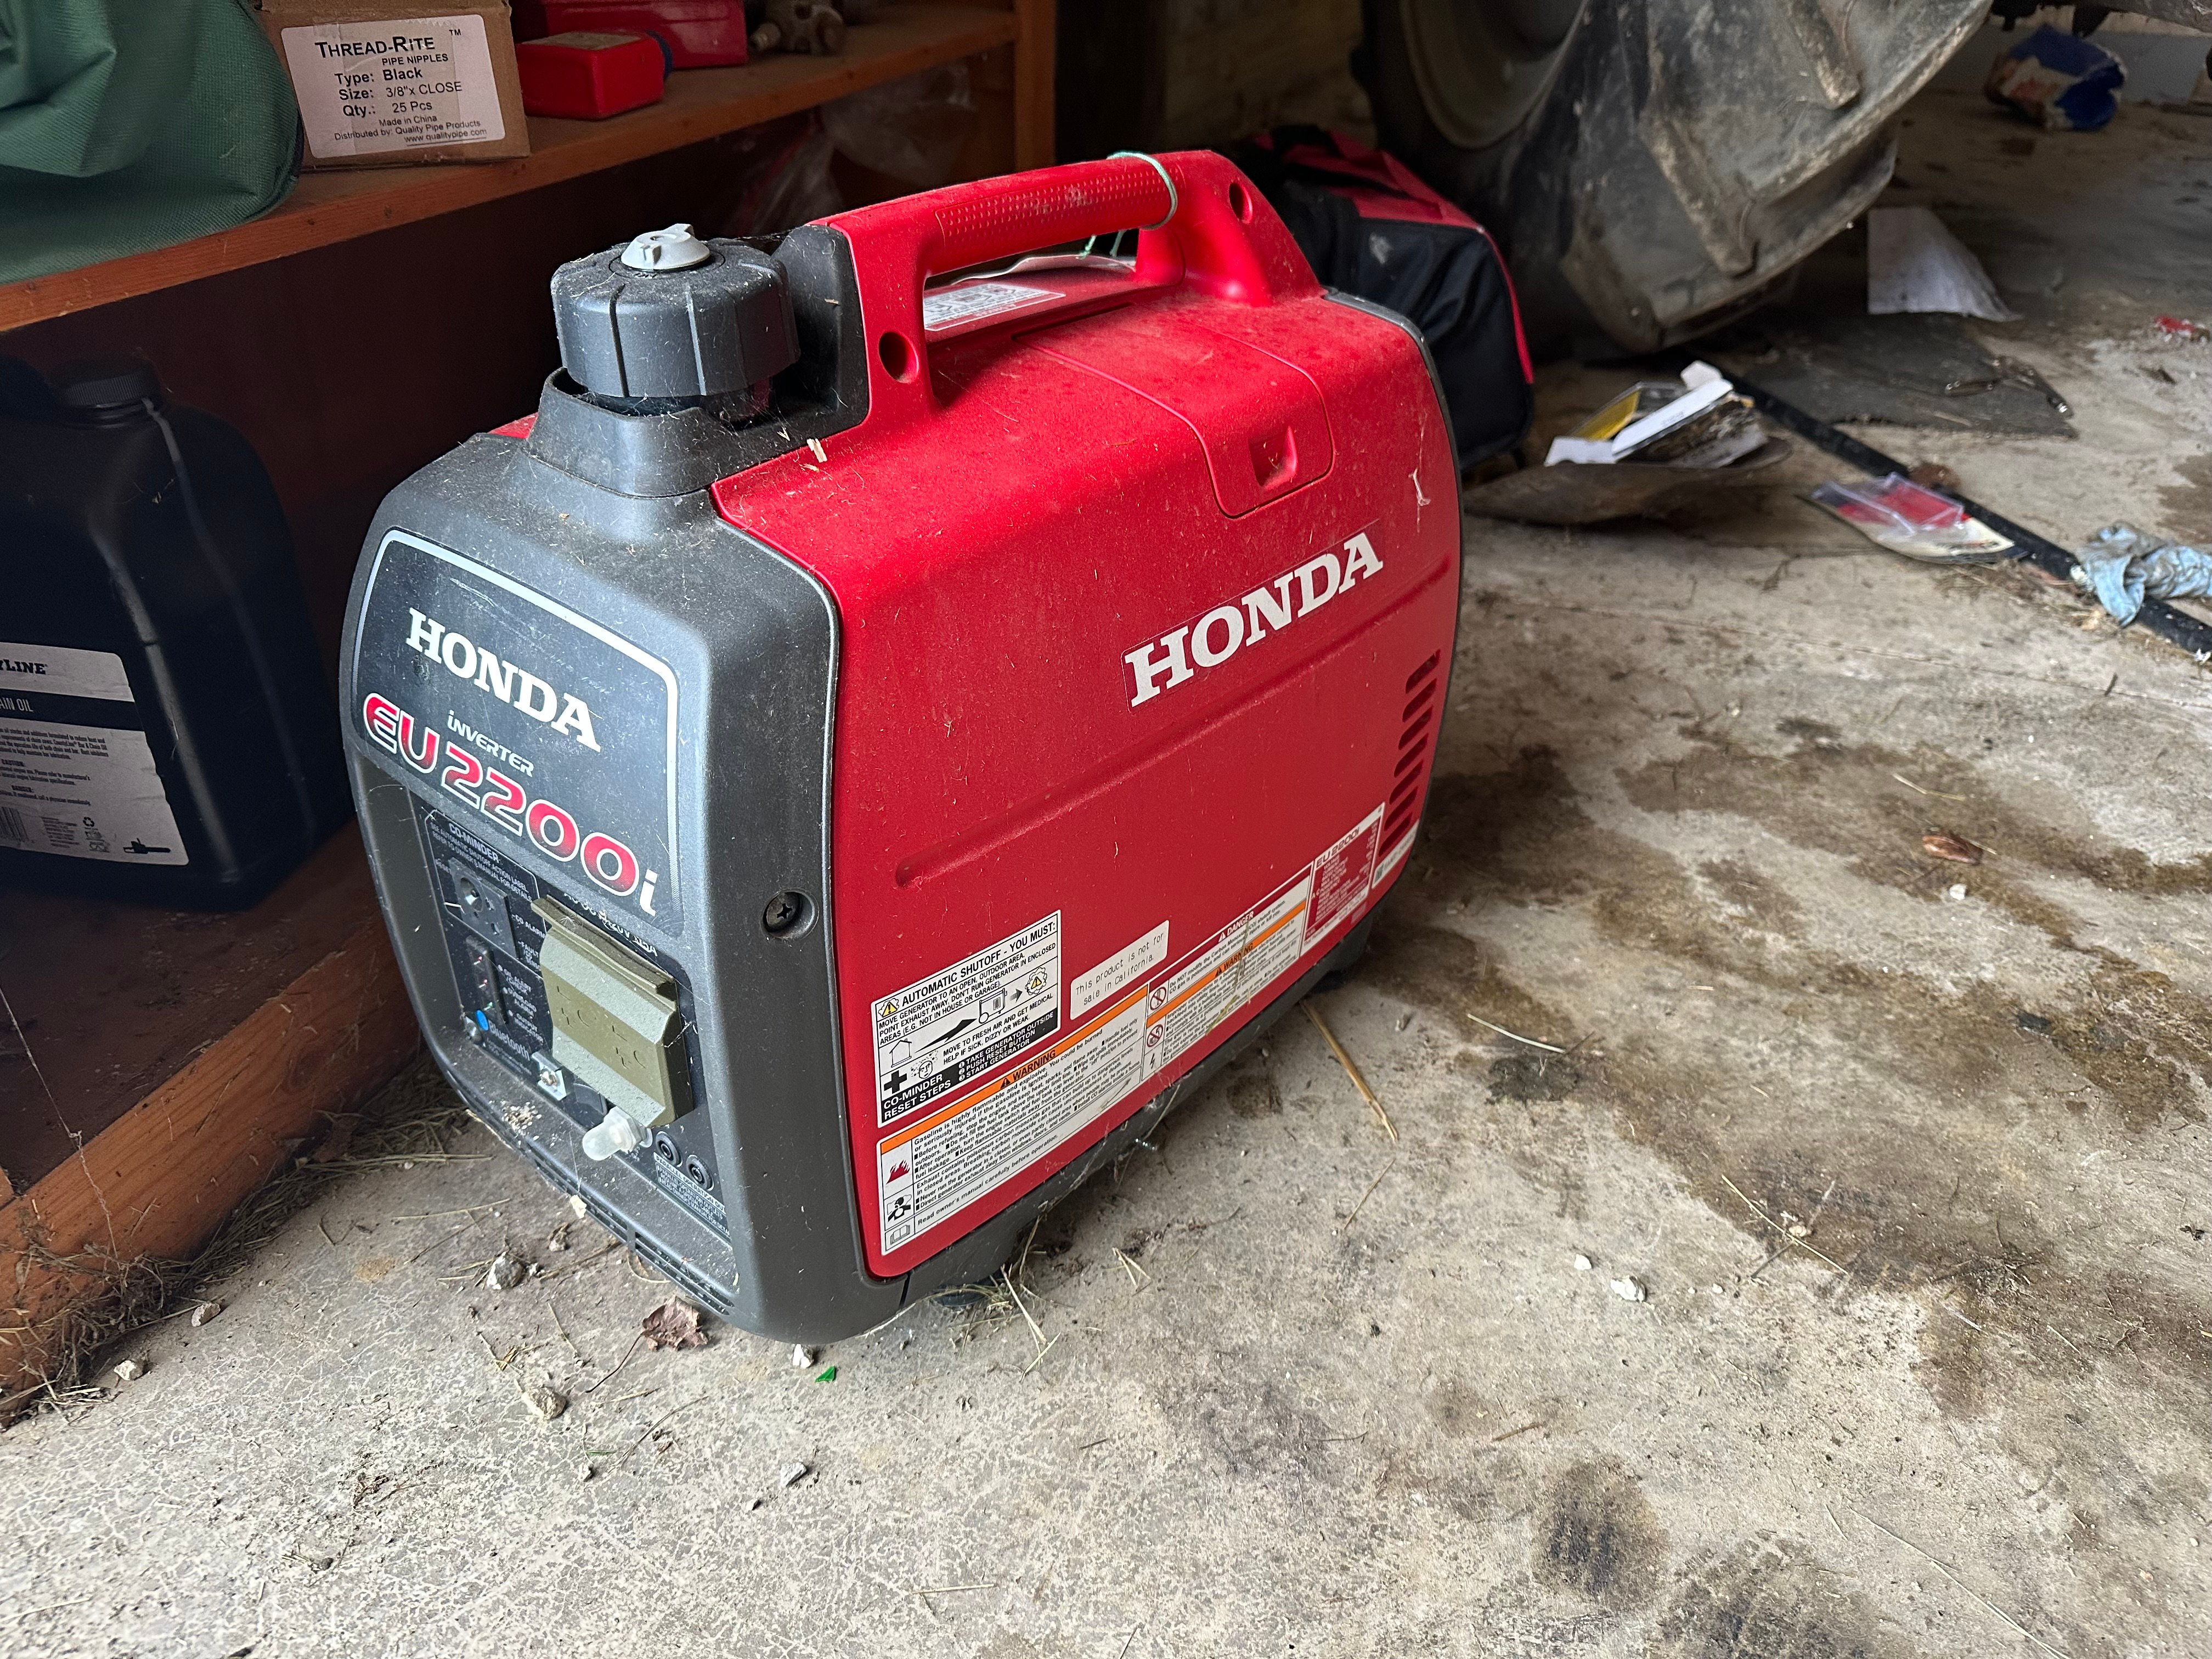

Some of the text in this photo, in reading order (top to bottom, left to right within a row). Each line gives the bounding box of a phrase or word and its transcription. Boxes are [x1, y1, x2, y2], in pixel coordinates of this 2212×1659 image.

[334, 67, 423, 87] Type: Black
[382, 54, 449, 65] PIPE NIPPLES
[339, 89, 374, 100] Size:
[419, 82, 462, 95] CLOSE
[343, 101, 432, 117] Qty.: 25 Pcs
[334, 129, 379, 140] Distributed
[395, 125, 424, 134] Quality
[425, 123, 444, 132] Pipe
[445, 120, 481, 129] Products
[379, 118, 402, 127] Made
[414, 115, 437, 123] China
[1125, 532, 1384, 708] HONDA
[405, 607, 601, 753] HONDA
[16, 698, 33, 712] OIL
[439, 827, 469, 853] AUTOMATIC
[469, 847, 490, 868] SHUTOFF
[492, 862, 511, 882] ACTION
[448, 821, 499, 864] CO-MINDER
[477, 861, 500, 882] MANUAL
[500, 876, 510, 889] FOR
[515, 913, 524, 926] CO
[521, 940, 539, 958] FAULT
[902, 922, 1054, 1006] AUTOMATIC SHUTOFF YOU MUST:
[1076, 933, 1163, 995] This product is not for
[1222, 941, 1254, 972] WARNNG
[503, 967, 531, 992] OIL ALERT
[879, 1023, 899, 1037] POINT
[901, 1008, 929, 1026] EXHAUST
[971, 981, 983, 992] RUN
[985, 962, 1019, 984] GENERATOR
[1020, 958, 1026, 967] IN
[1028, 943, 1055, 962] ENCLOSED
[879, 1015, 898, 1029] MOVE
[899, 996, 936, 1019] GENERATOR
[939, 991, 947, 1000] TO
[949, 985, 957, 996] AN
[979, 961, 1007, 979] OUTDOOR
[1084, 989, 1099, 1005] sale
[1104, 981, 1111, 992] in
[1177, 971, 1187, 983] NOT
[516, 1012, 538, 1032] OUTPUT
[880, 1030, 901, 1045] AREAS
[919, 1014, 932, 1026] NOT
[934, 1010, 940, 1019] IN
[942, 1000, 962, 1014] HOUSE
[964, 994, 973, 1003] OR
[943, 993, 1052, 1056] MOVE TO FRESH AIR AND GET MEDICAL
[966, 1011, 1053, 1064] TAKE GENERATOR OUTSIDE
[487, 1018, 530, 1062] Bluetooth
[943, 1052, 959, 1064] HELP
[985, 1029, 1001, 1042] DIZZY
[1003, 1024, 1011, 1032] OR
[966, 1029, 1035, 1071] PUSH RESET BUTTON
[966, 1039, 1029, 1077] START GENERATOR
[1013, 1049, 1055, 1081] WARNING
[884, 1074, 942, 1108] CO-MINDER
[884, 1080, 950, 1120] RESET STEPS
[914, 1127, 942, 1144] Gasoline
[951, 1111, 970, 1125] highly
[972, 1092, 1005, 1113] flammable
[1006, 1082, 1017, 1093] and
[1049, 1058, 1059, 1067] You
[1060, 1047, 1075, 1060] could
[1084, 1029, 1102, 1045] burned
[924, 1128, 952, 1147] seriously
[954, 1113, 976, 1130] injured
[984, 1105, 993, 1113] the
[995, 1090, 1020, 1108] gasoline
[917, 1091, 1071, 1190] Exhaust contains poisonous carbon monoxide gas that can
[918, 1211, 934, 1225] Read
[961, 1181, 983, 1199] manual
[985, 1165, 1009, 1184] carefully
[1011, 1153, 1029, 1167] before
